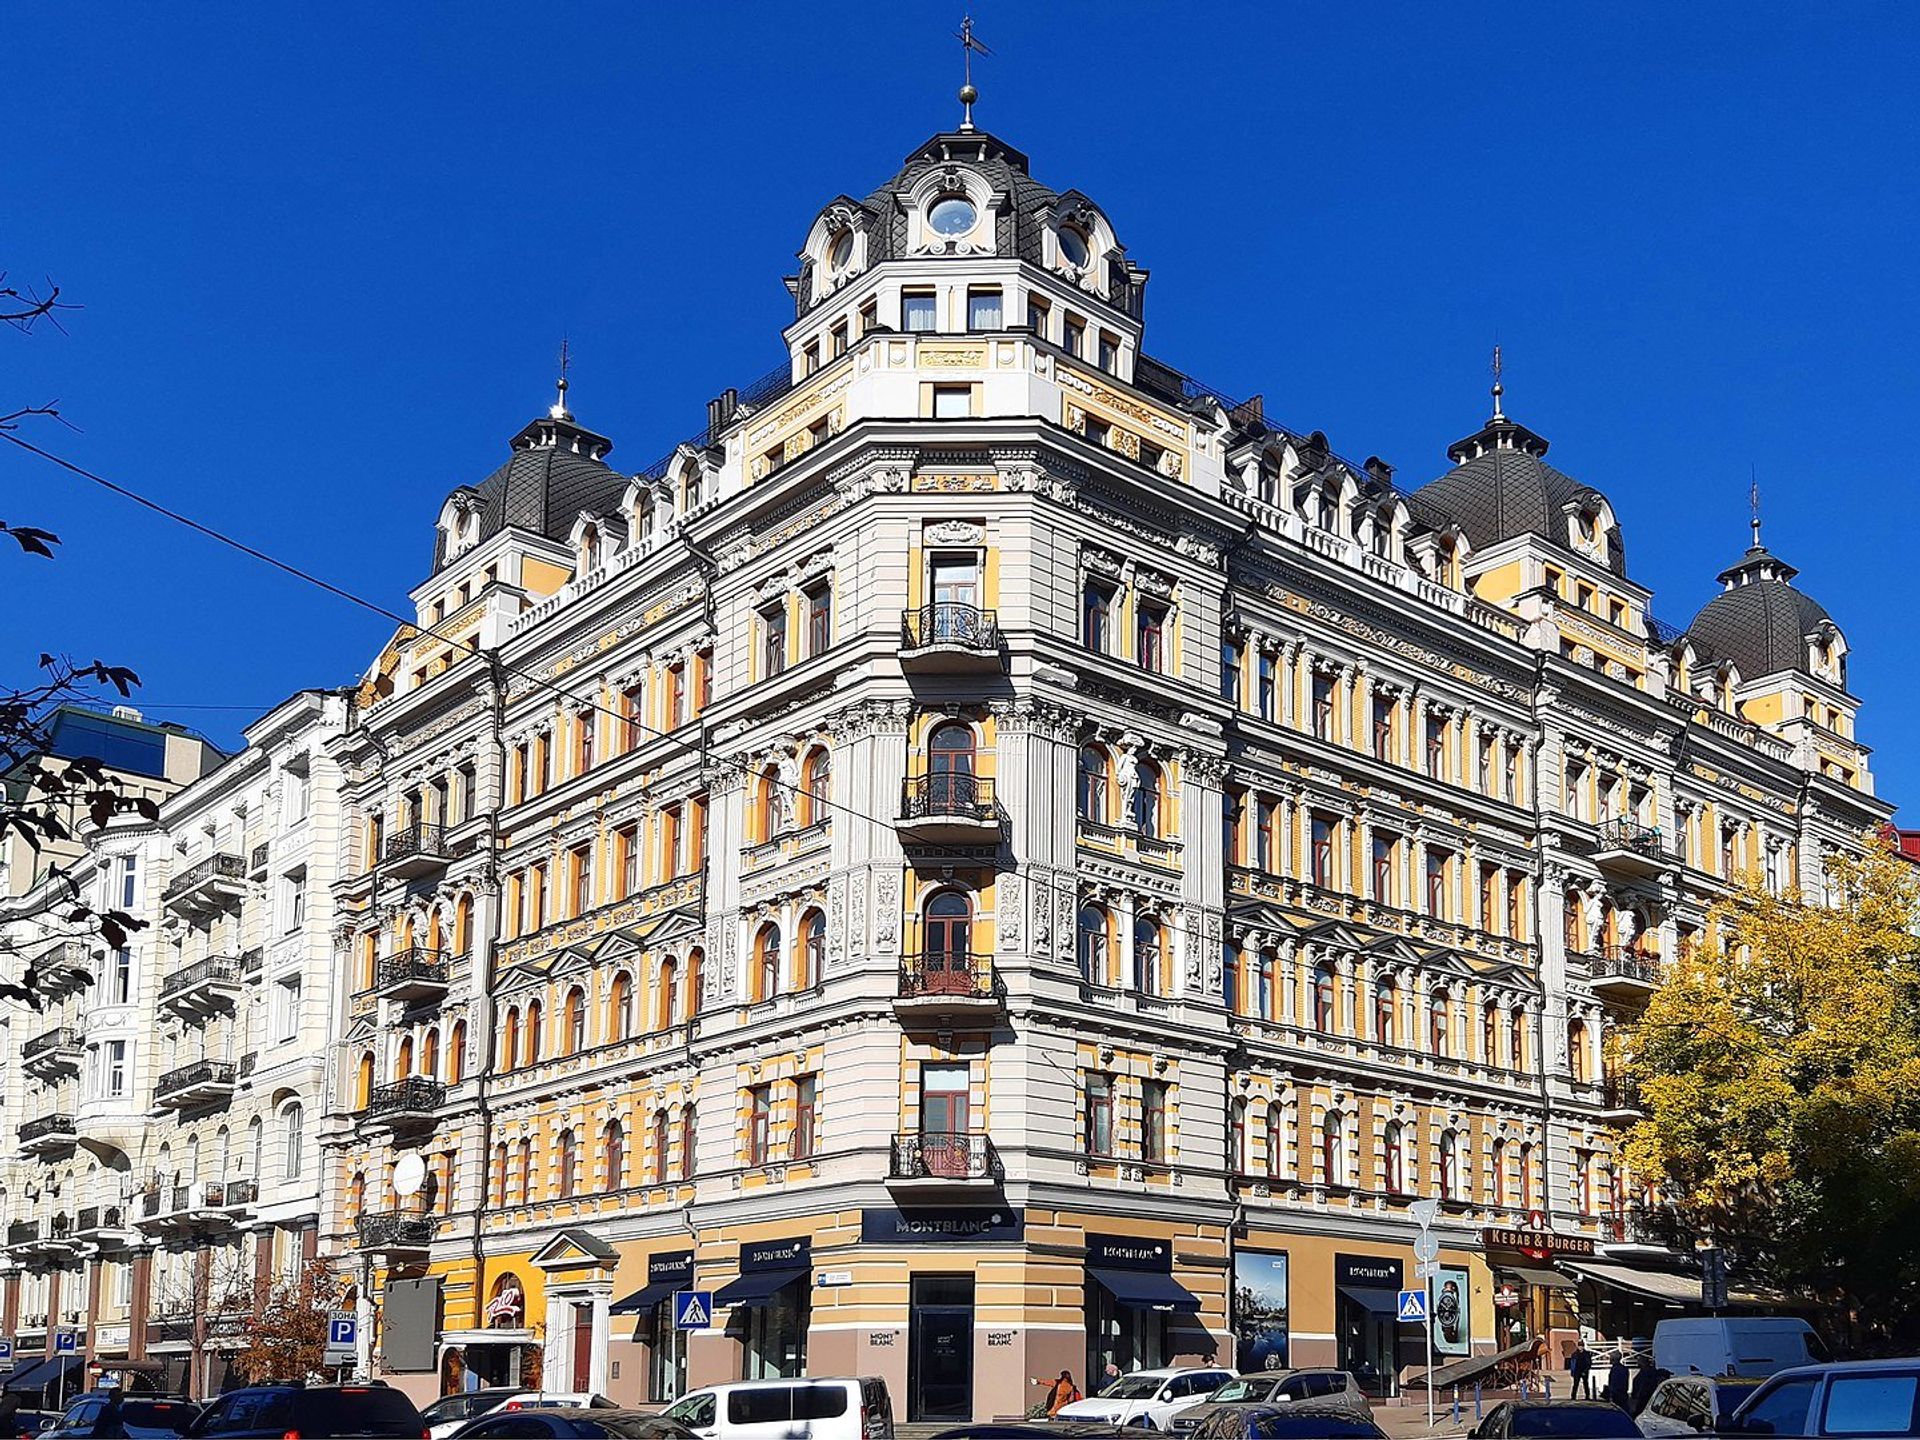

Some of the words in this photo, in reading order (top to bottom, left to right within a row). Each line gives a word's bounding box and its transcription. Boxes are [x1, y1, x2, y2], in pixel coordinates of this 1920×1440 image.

[896, 1220, 990, 1232] MONTBLANC
[1492, 1229, 1531, 1246] KEBAB
[1534, 1233, 1543, 1247] &
[1547, 1236, 1590, 1252] BURGER
[332, 1312, 356, 1320] ЗОНА
[337, 1322, 351, 1341] P
